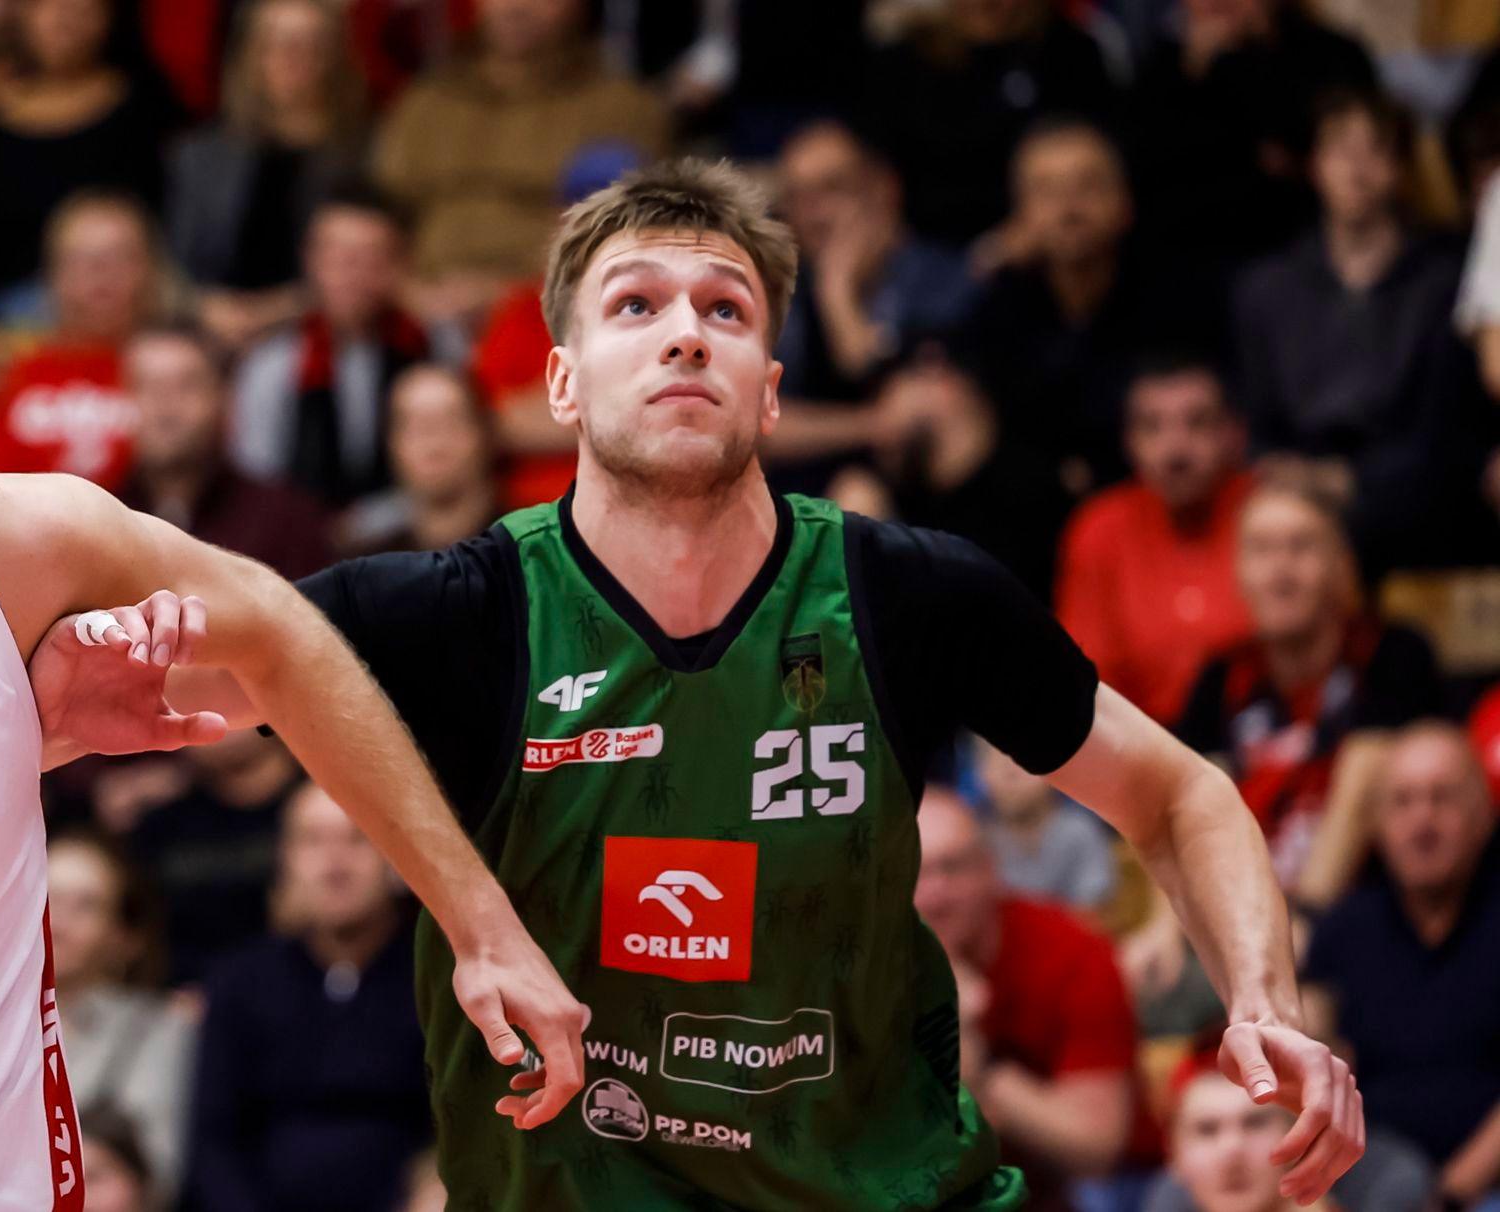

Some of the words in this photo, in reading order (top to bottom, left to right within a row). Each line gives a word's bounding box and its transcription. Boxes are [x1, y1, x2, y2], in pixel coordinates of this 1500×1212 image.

[538, 670, 607, 711] 4F
[615, 729, 654, 742] Basket
[615, 745, 638, 757] Liga
[525, 743, 576, 764] RLEN
[751, 722, 865, 820] 25
[623, 933, 729, 960] ORLEN
[586, 1041, 648, 1075] WUM
[673, 1036, 717, 1059] PIB
[724, 1034, 824, 1068] NOWUM
[655, 1115, 687, 1133] PP
[694, 1122, 751, 1149] DOM
